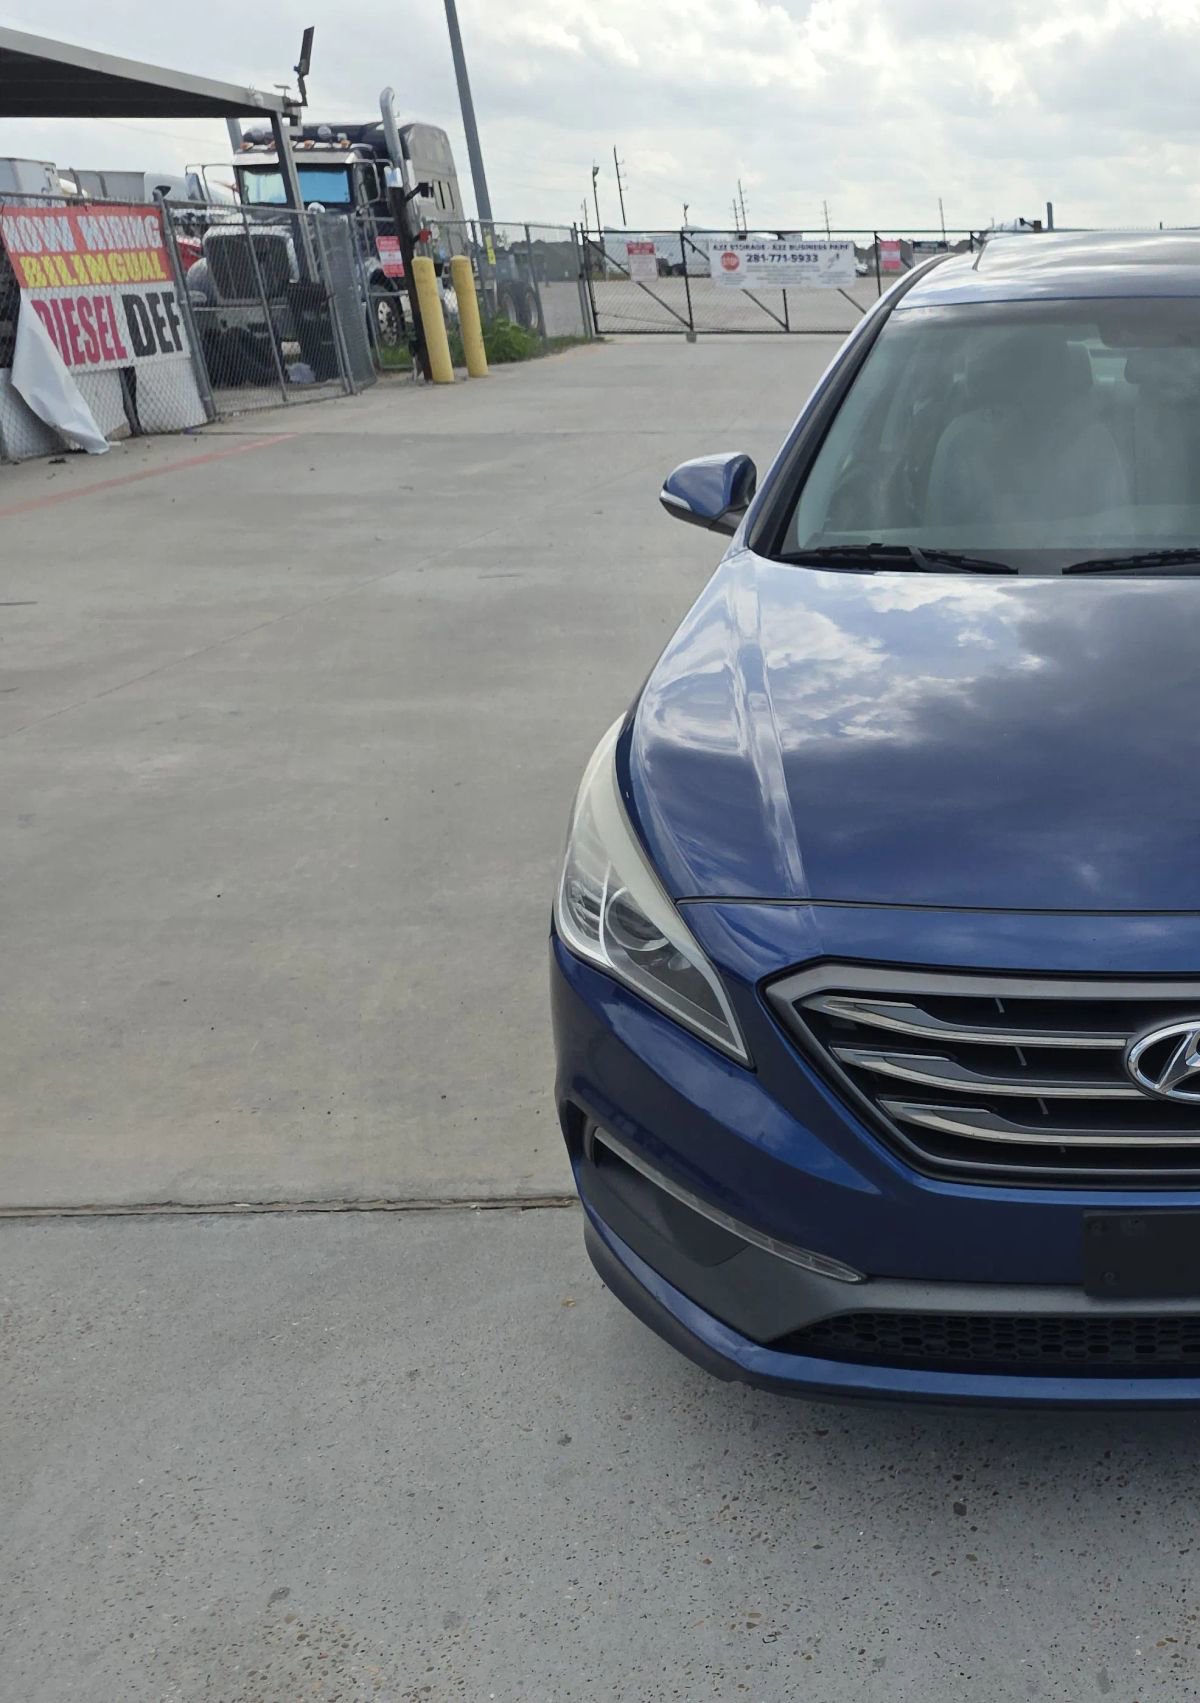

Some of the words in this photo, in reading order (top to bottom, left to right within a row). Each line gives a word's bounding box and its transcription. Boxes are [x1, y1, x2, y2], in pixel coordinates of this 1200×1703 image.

[77, 215, 163, 251] HIRING
[20, 251, 168, 288] BILINGUAL
[746, 254, 819, 263] 281-771-5933
[121, 291, 184, 358] DEF
